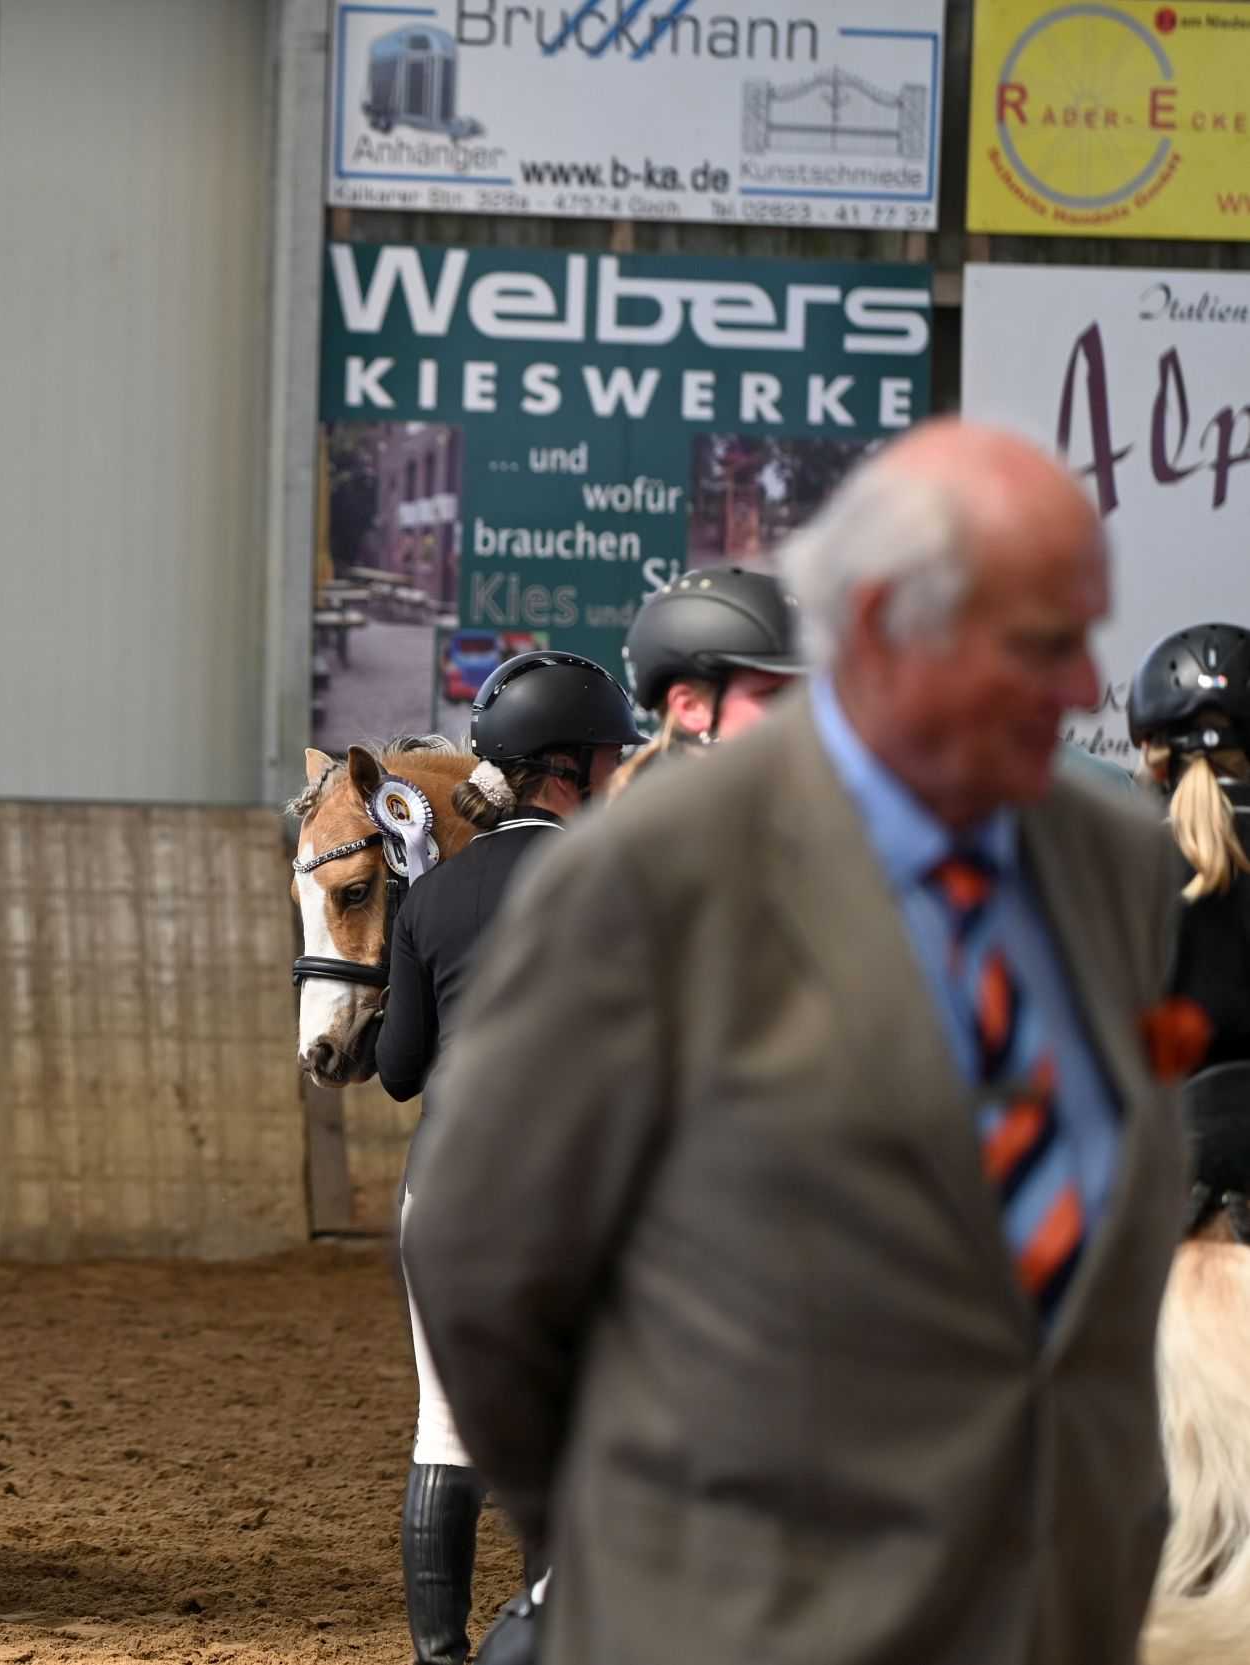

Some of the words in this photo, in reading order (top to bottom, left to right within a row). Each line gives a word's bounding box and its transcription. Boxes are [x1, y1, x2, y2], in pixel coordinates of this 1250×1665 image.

[519, 155, 730, 194] www.b-ka.de
[739, 160, 924, 188] Kunstschmiede
[330, 244, 931, 354] Welbers
[346, 357, 912, 426] KIESWERKE
[529, 441, 588, 474] und
[582, 475, 682, 514] wofür
[474, 518, 641, 561] brauchen
[470, 570, 580, 628] Kies
[643, 557, 682, 603] Si
